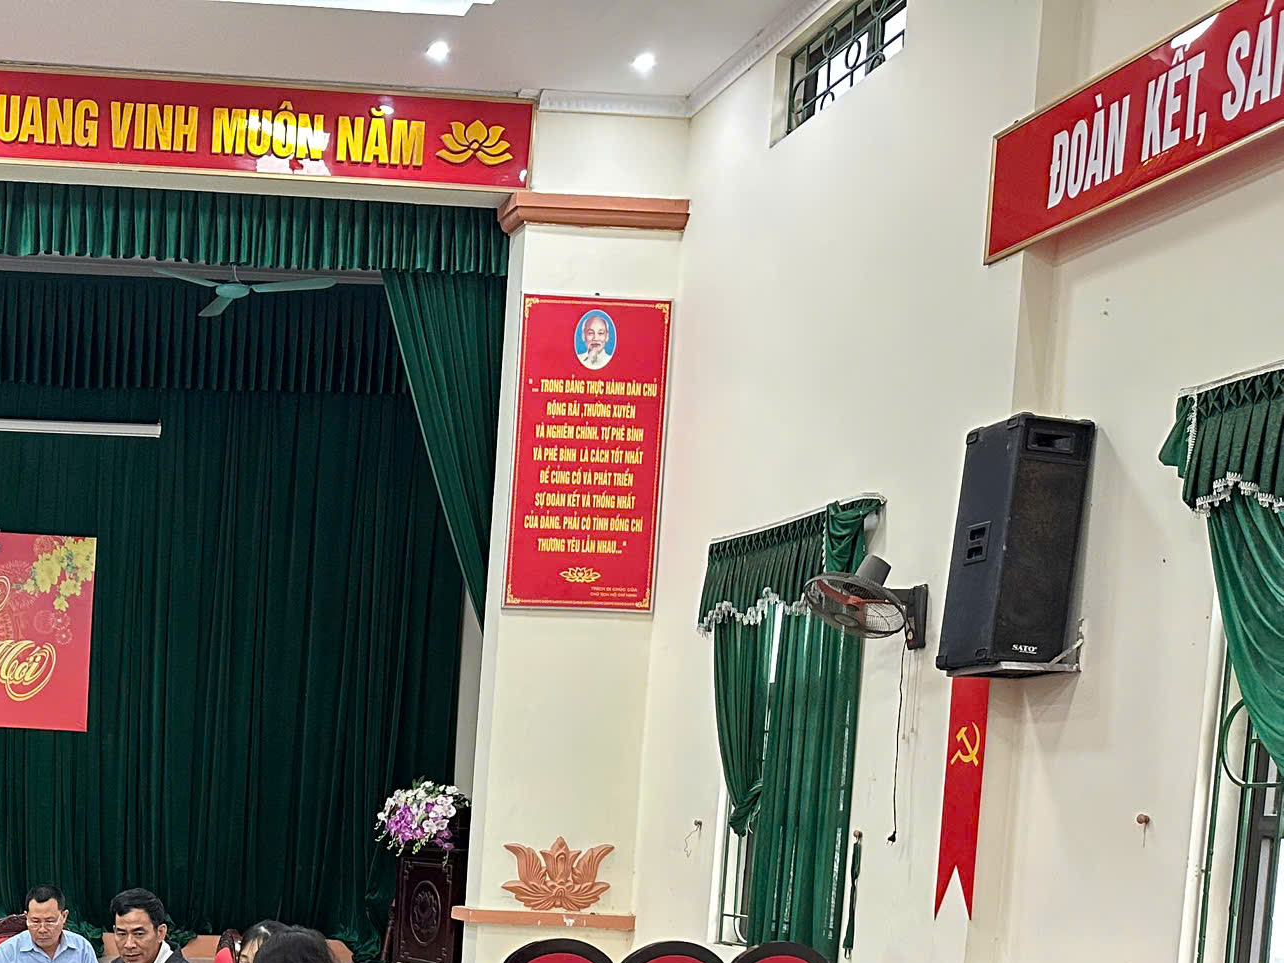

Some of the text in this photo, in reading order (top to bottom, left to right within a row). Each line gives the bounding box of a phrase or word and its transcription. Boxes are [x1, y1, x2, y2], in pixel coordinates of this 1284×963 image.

[110, 101, 199, 153] VINH
[211, 101, 326, 160] MUÔN
[336, 104, 427, 167] NĂM
[1047, 93, 1131, 210] ĐOÀN
[541, 379, 564, 393] TRONG
[565, 374, 585, 394] ĐẢNG
[587, 379, 604, 396] THỰC
[605, 379, 625, 395] HÀNH
[626, 380, 641, 396] DÂN
[643, 378, 657, 397] CHỦ
[547, 400, 566, 417] RỘNG
[612, 403, 636, 418] XUYÊN
[536, 422, 544, 438] VÀ
[546, 422, 574, 439] NGHIÊM
[601, 426, 610, 443] TỰ
[611, 425, 625, 441] PHÊ
[626, 426, 644, 441] BÌNH
[533, 445, 643, 464] VÀ PHÊ BÌNH LÀ CÁCH TỐT NHẤT
[540, 465, 633, 486] ĐỂ CỦNG CỐ VÀ PHÁT TRIỂN
[535, 490, 635, 509] SỰ ĐOÀN KẾT VÀ THỐNG NHẤT
[524, 510, 538, 528] CỦA
[540, 510, 561, 529] ĐẢNG.
[563, 511, 580, 530] PHẢI
[581, 515, 591, 530] CÓ
[593, 515, 608, 530] TÌNH
[631, 517, 643, 532] CHÍ
[538, 538, 565, 552] THƯƠNG
[567, 537, 580, 552] YÊU
